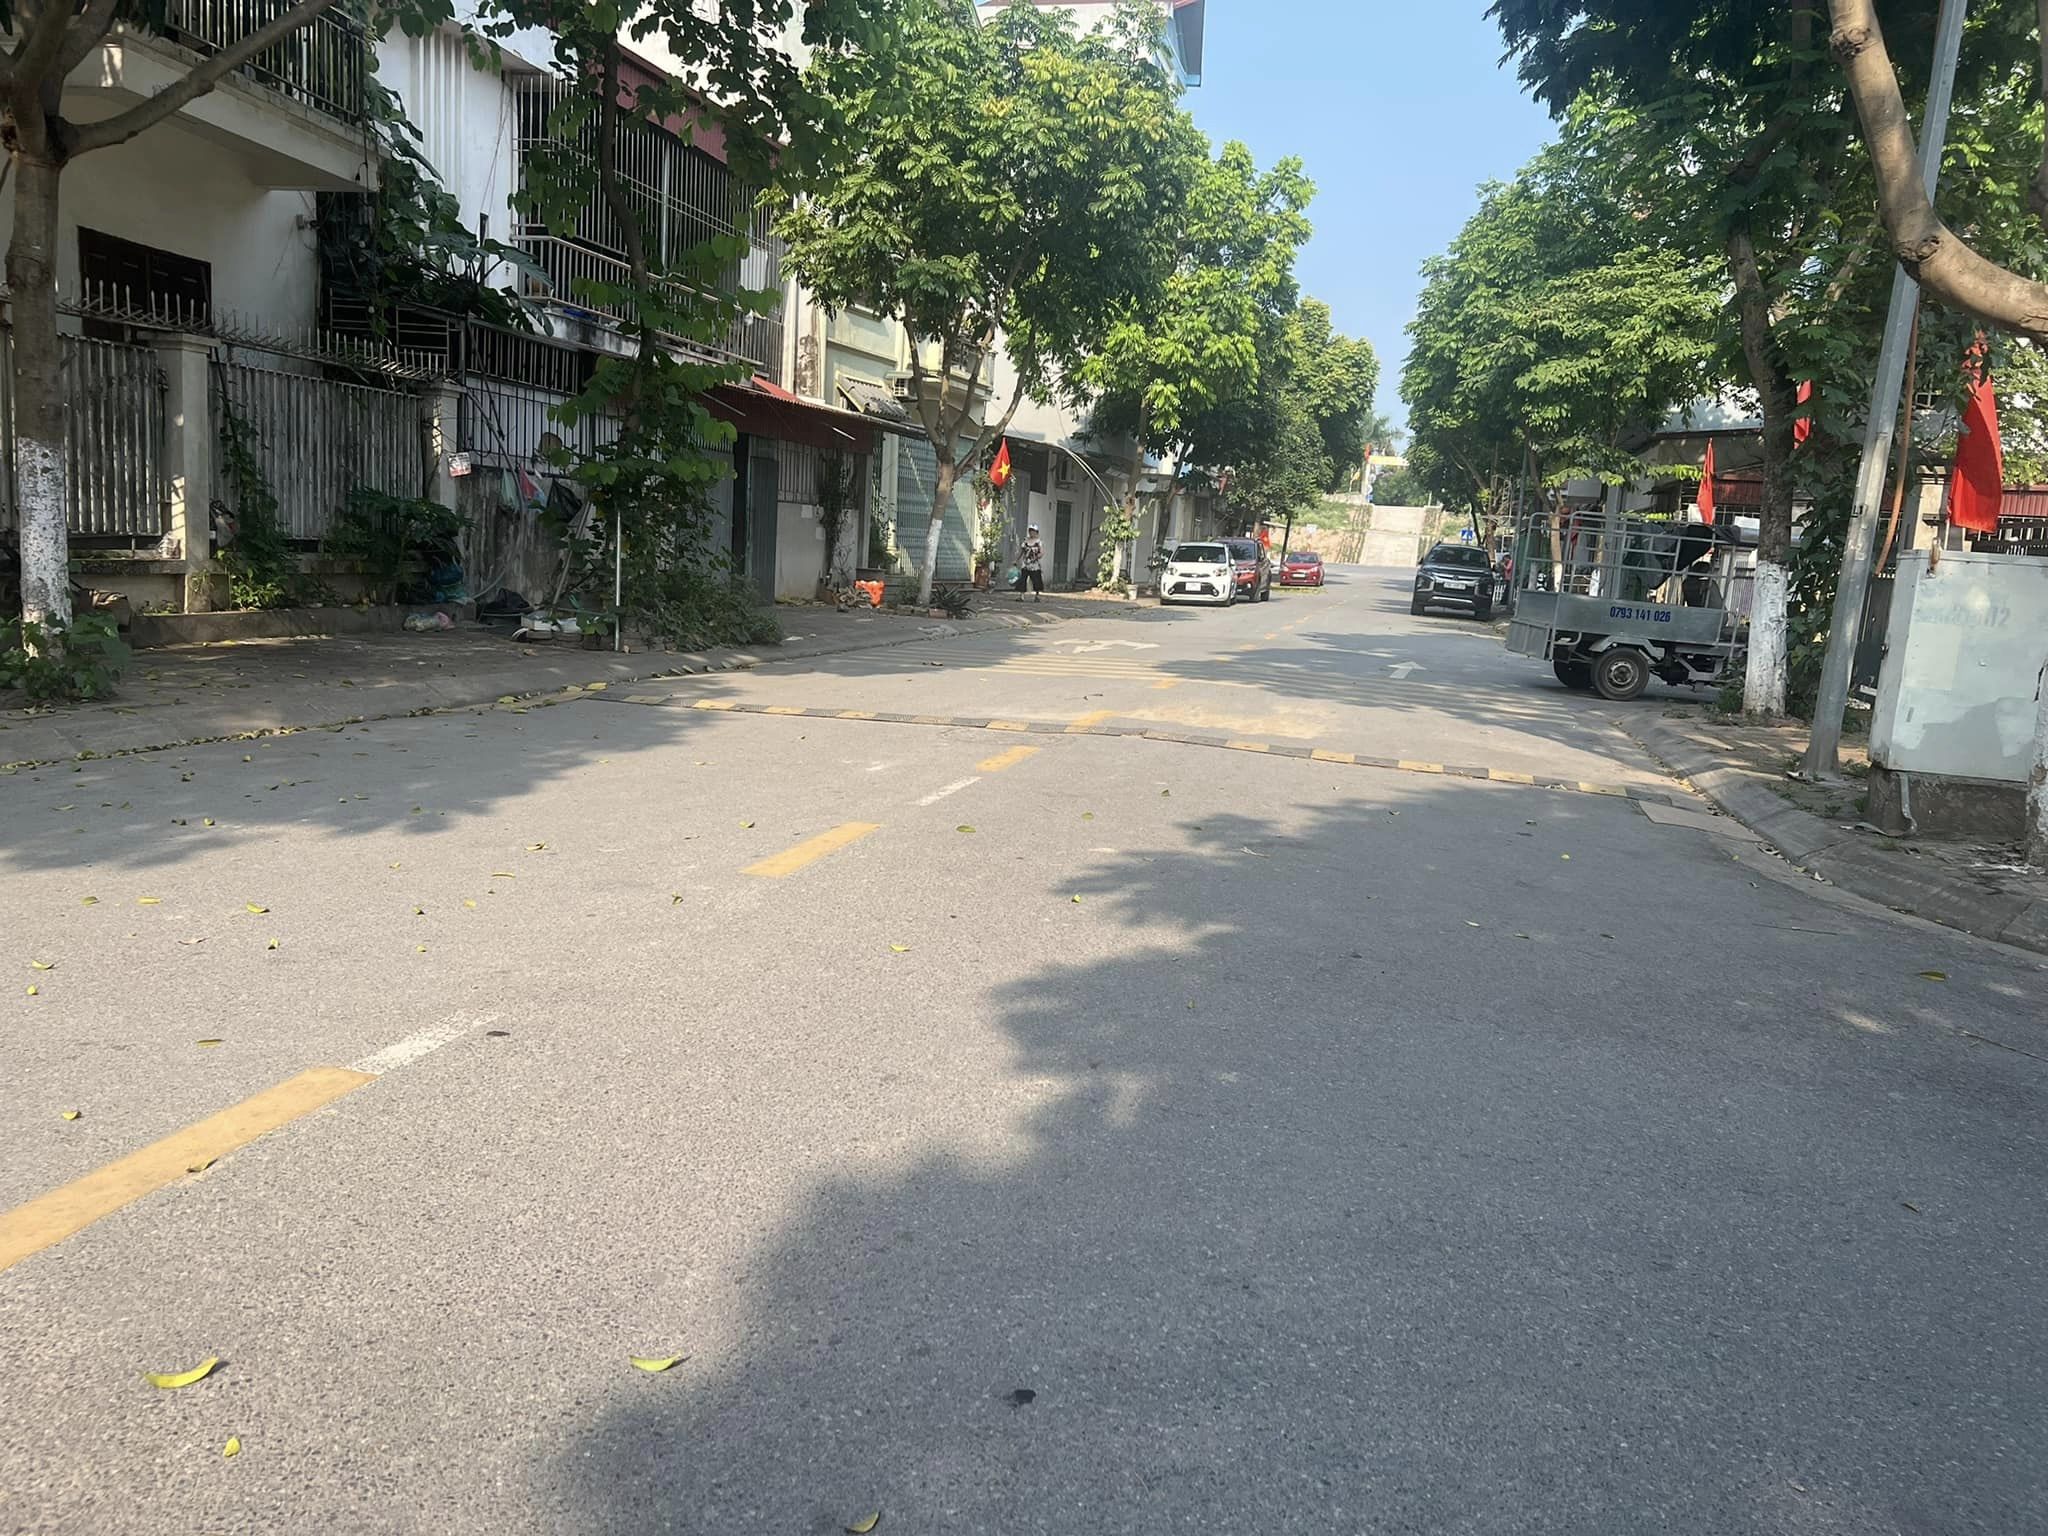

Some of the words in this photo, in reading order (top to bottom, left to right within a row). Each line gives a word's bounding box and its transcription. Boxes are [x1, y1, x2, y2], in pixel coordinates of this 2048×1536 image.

[1610, 606, 1632, 619] 0793
[1636, 609, 1650, 621] 141
[1654, 610, 1671, 622] 026
